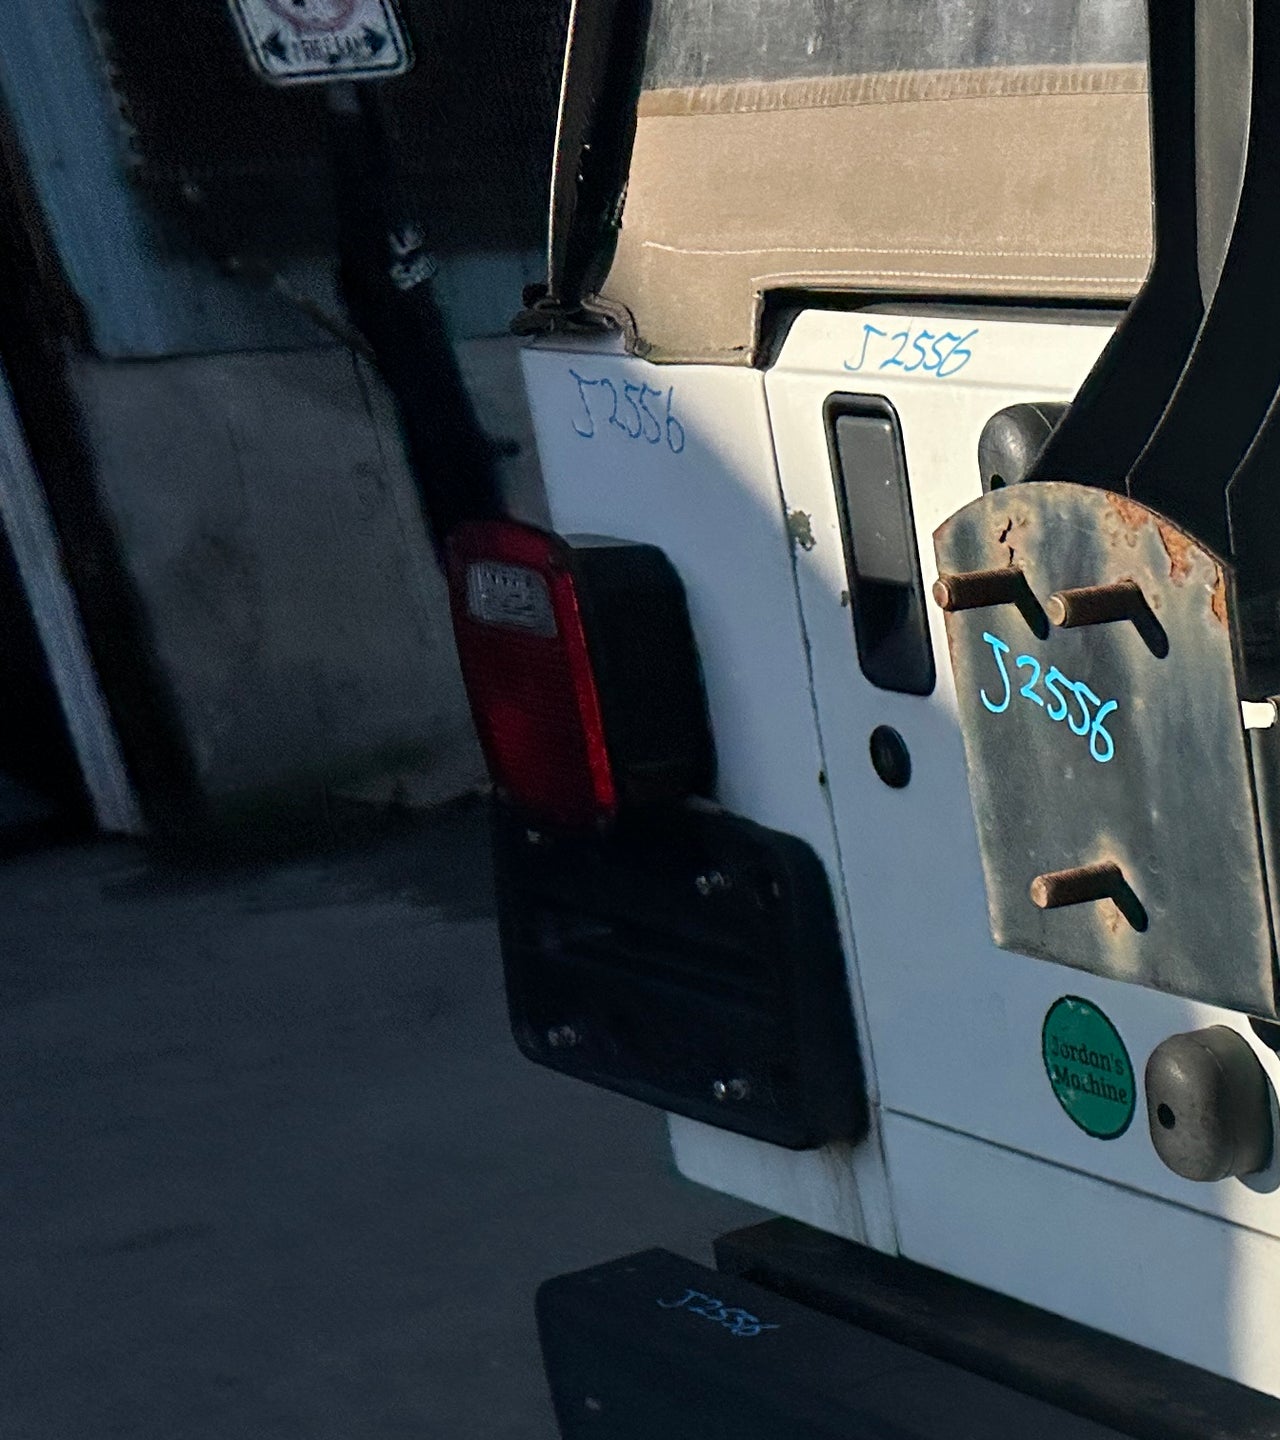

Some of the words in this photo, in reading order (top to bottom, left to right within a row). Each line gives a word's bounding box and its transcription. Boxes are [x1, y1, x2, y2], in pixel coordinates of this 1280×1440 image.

[844, 324, 980, 379] J2556
[569, 369, 686, 454] J2556
[980, 632, 1118, 764] J2556
[1050, 1035, 1124, 1076] Jordan's
[1052, 1064, 1128, 1105] Machine
